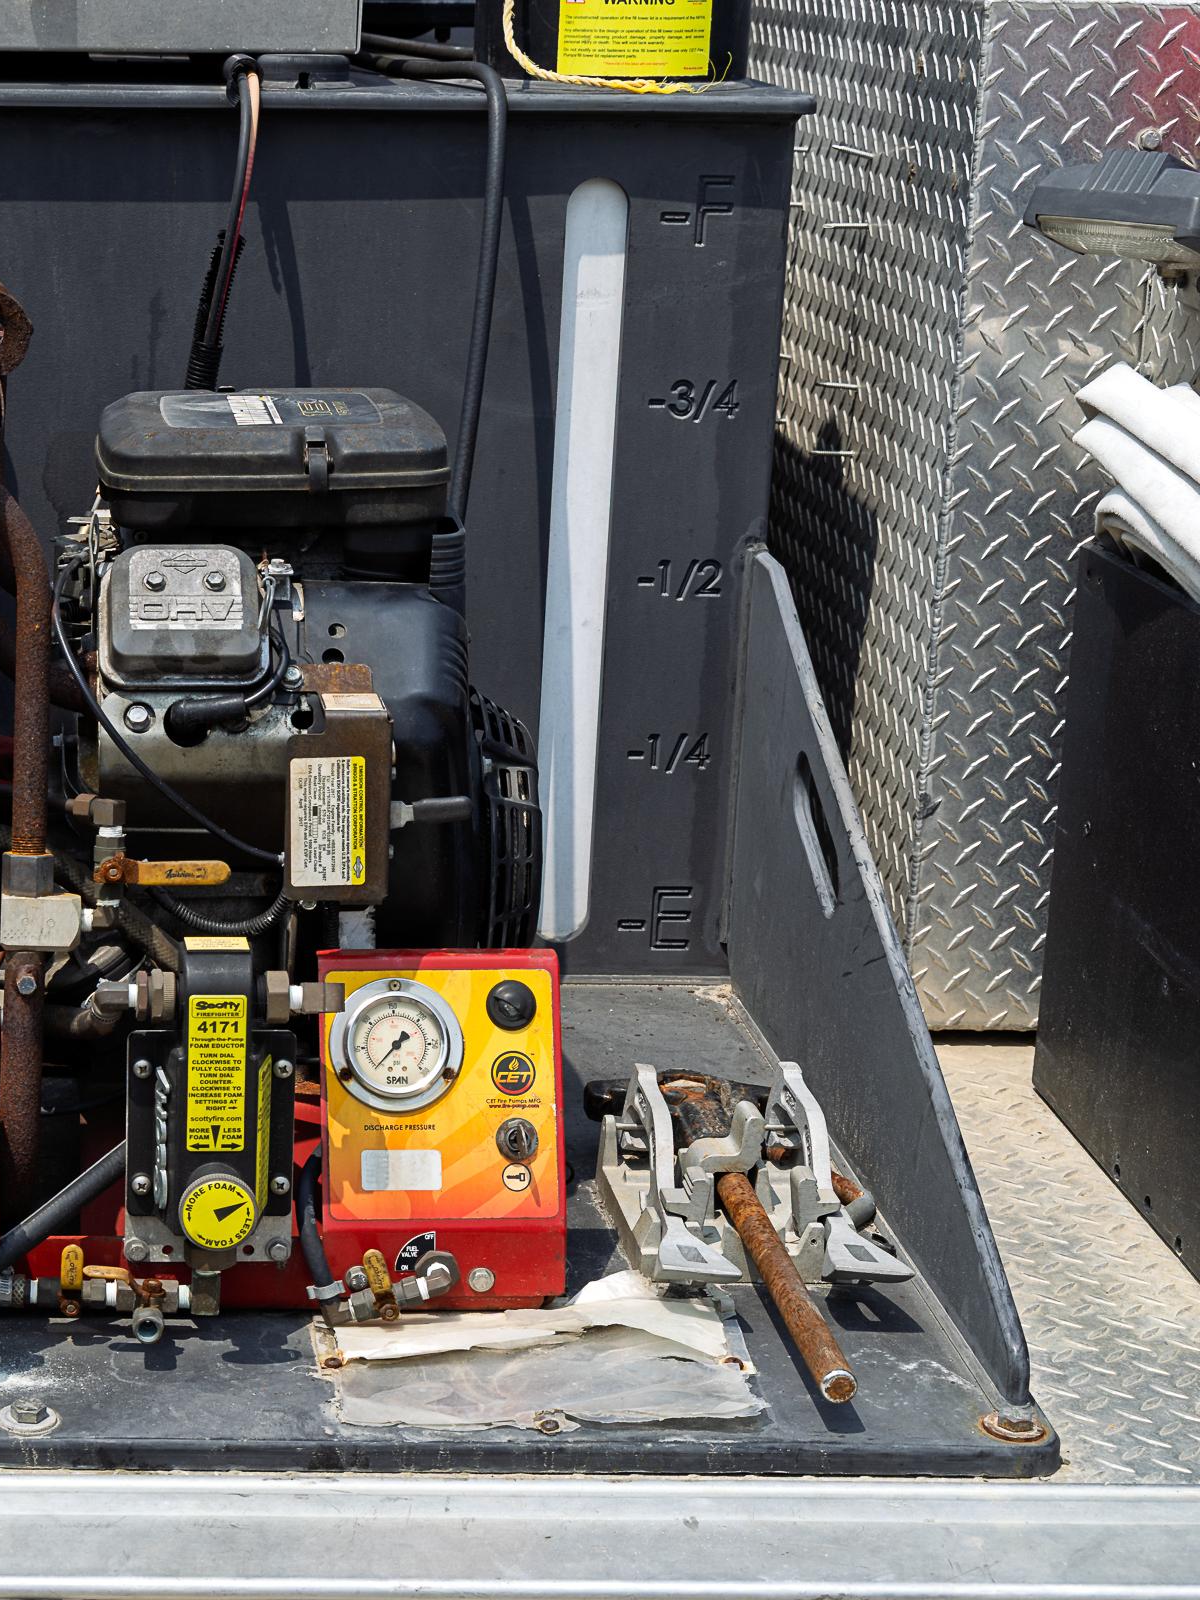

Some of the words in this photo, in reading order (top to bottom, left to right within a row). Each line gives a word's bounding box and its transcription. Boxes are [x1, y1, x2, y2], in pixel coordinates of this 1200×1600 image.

[138, 597, 235, 621] OHV
[195, 1001, 240, 1011] Scotty
[197, 1021, 239, 1033] 4171
[386, 1076, 408, 1084] SPAN
[496, 1071, 531, 1083] CET
[185, 1187, 206, 1212] MORE
[208, 1183, 237, 1192] FOAM
[235, 1218, 252, 1239] LESS
[205, 1238, 234, 1246] FOAM
